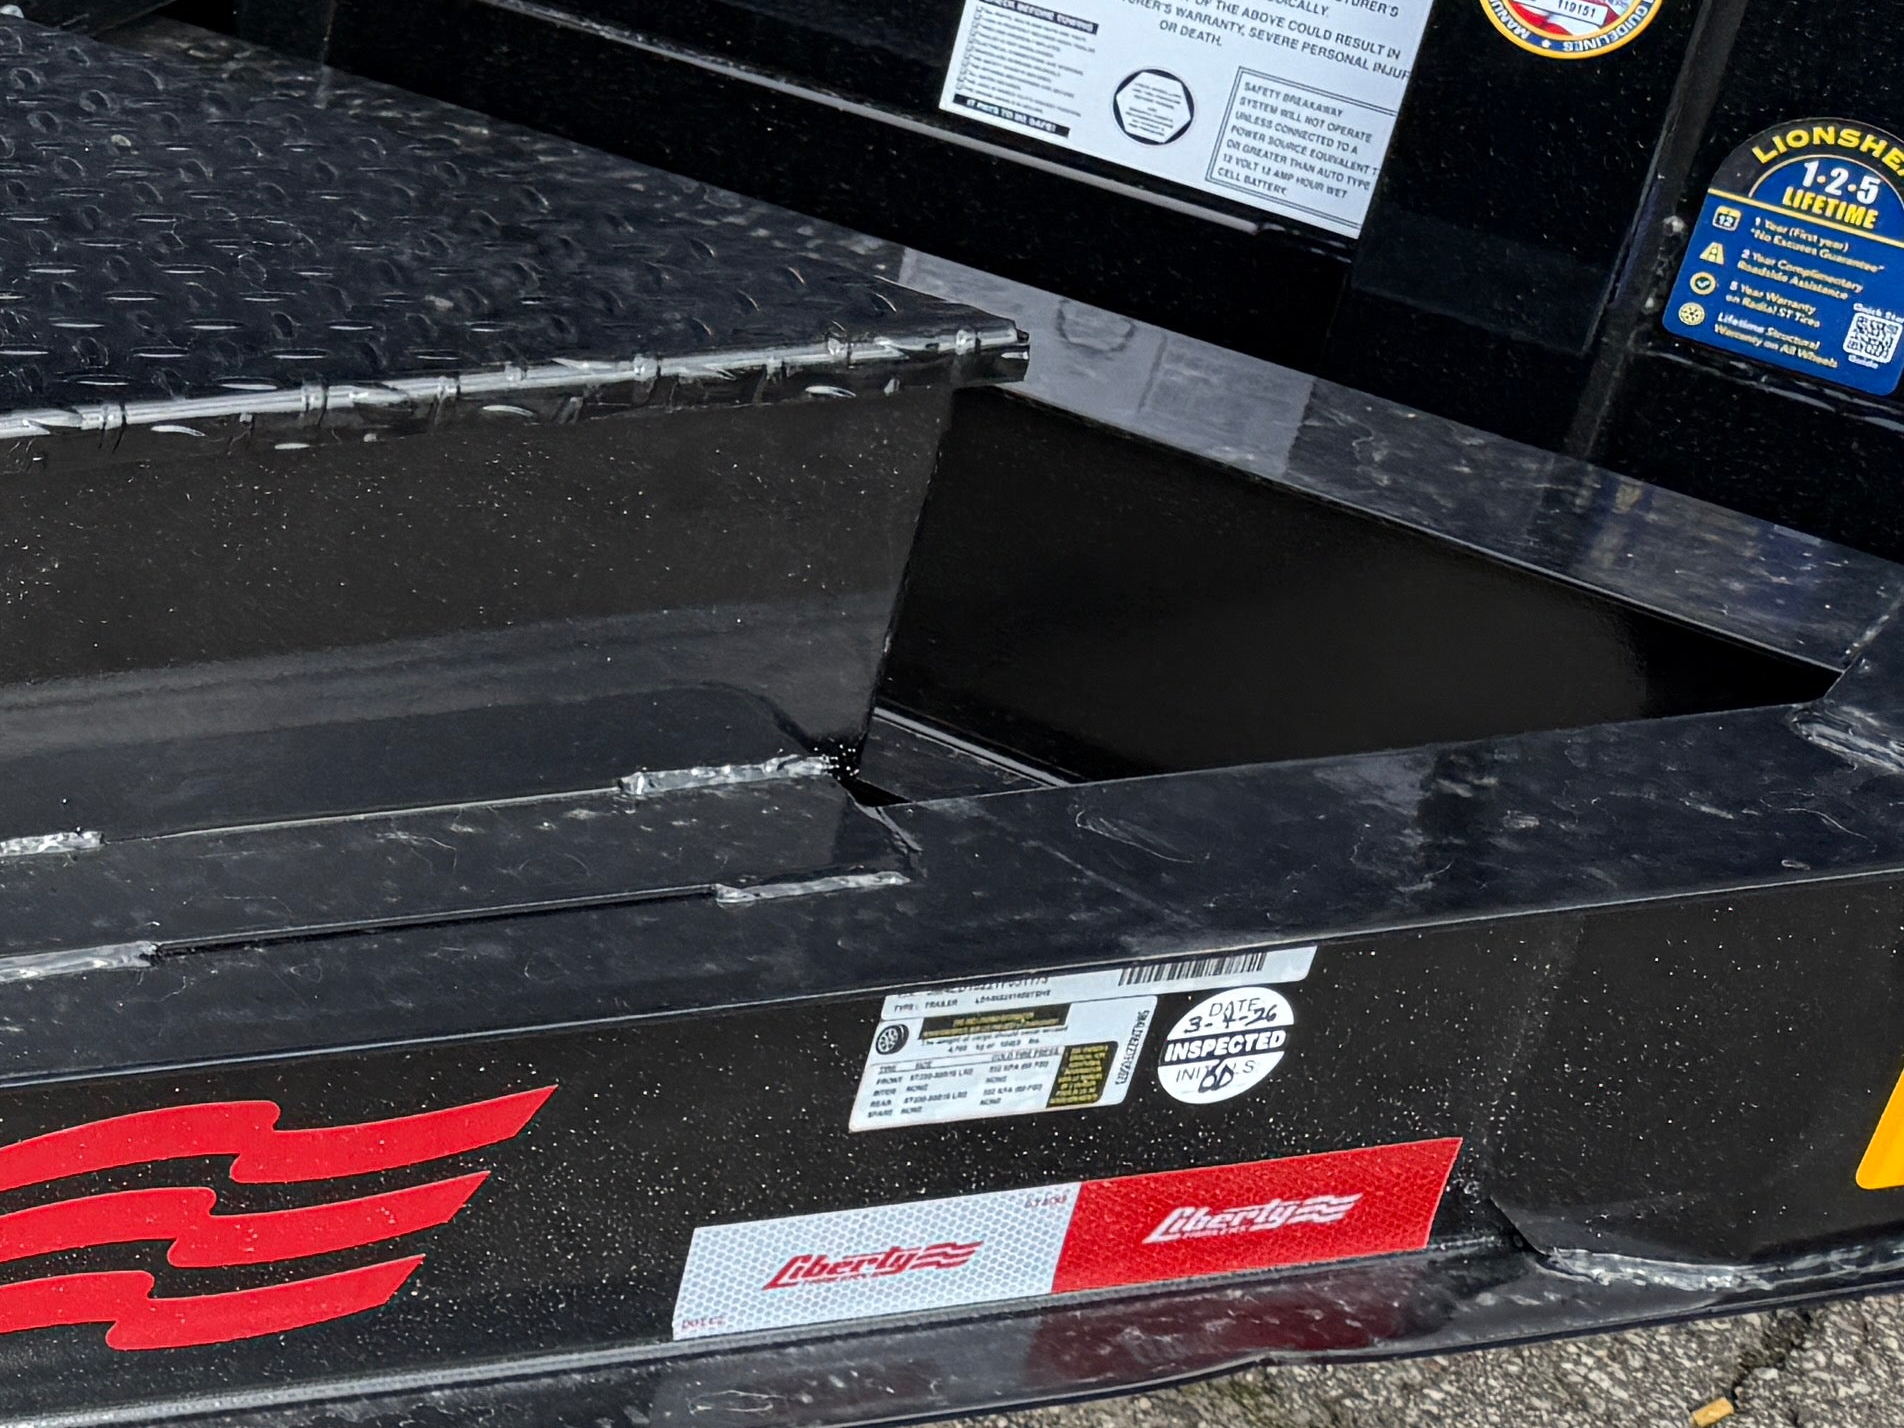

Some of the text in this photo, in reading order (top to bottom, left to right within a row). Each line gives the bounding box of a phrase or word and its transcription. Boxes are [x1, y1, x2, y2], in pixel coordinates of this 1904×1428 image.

[1158, 18, 1178, 33] OR
[1240, 6, 1286, 28] ABOVE
[1286, 19, 1333, 41] COULD
[1333, 31, 1386, 56] RESULT
[1385, 46, 1401, 61] IN
[1247, 25, 1299, 50] SEVERE
[1300, 40, 1369, 71] PERSONAL
[1562, 3, 1650, 52] GUIDELINES
[1782, 186, 1879, 230] LIFETIME
[1208, 997, 1261, 1017] DATE
[1163, 1029, 1287, 1063] INSPECTED
[1142, 1198, 1300, 1245] Liberty
[762, 1245, 923, 1291] Liberty
